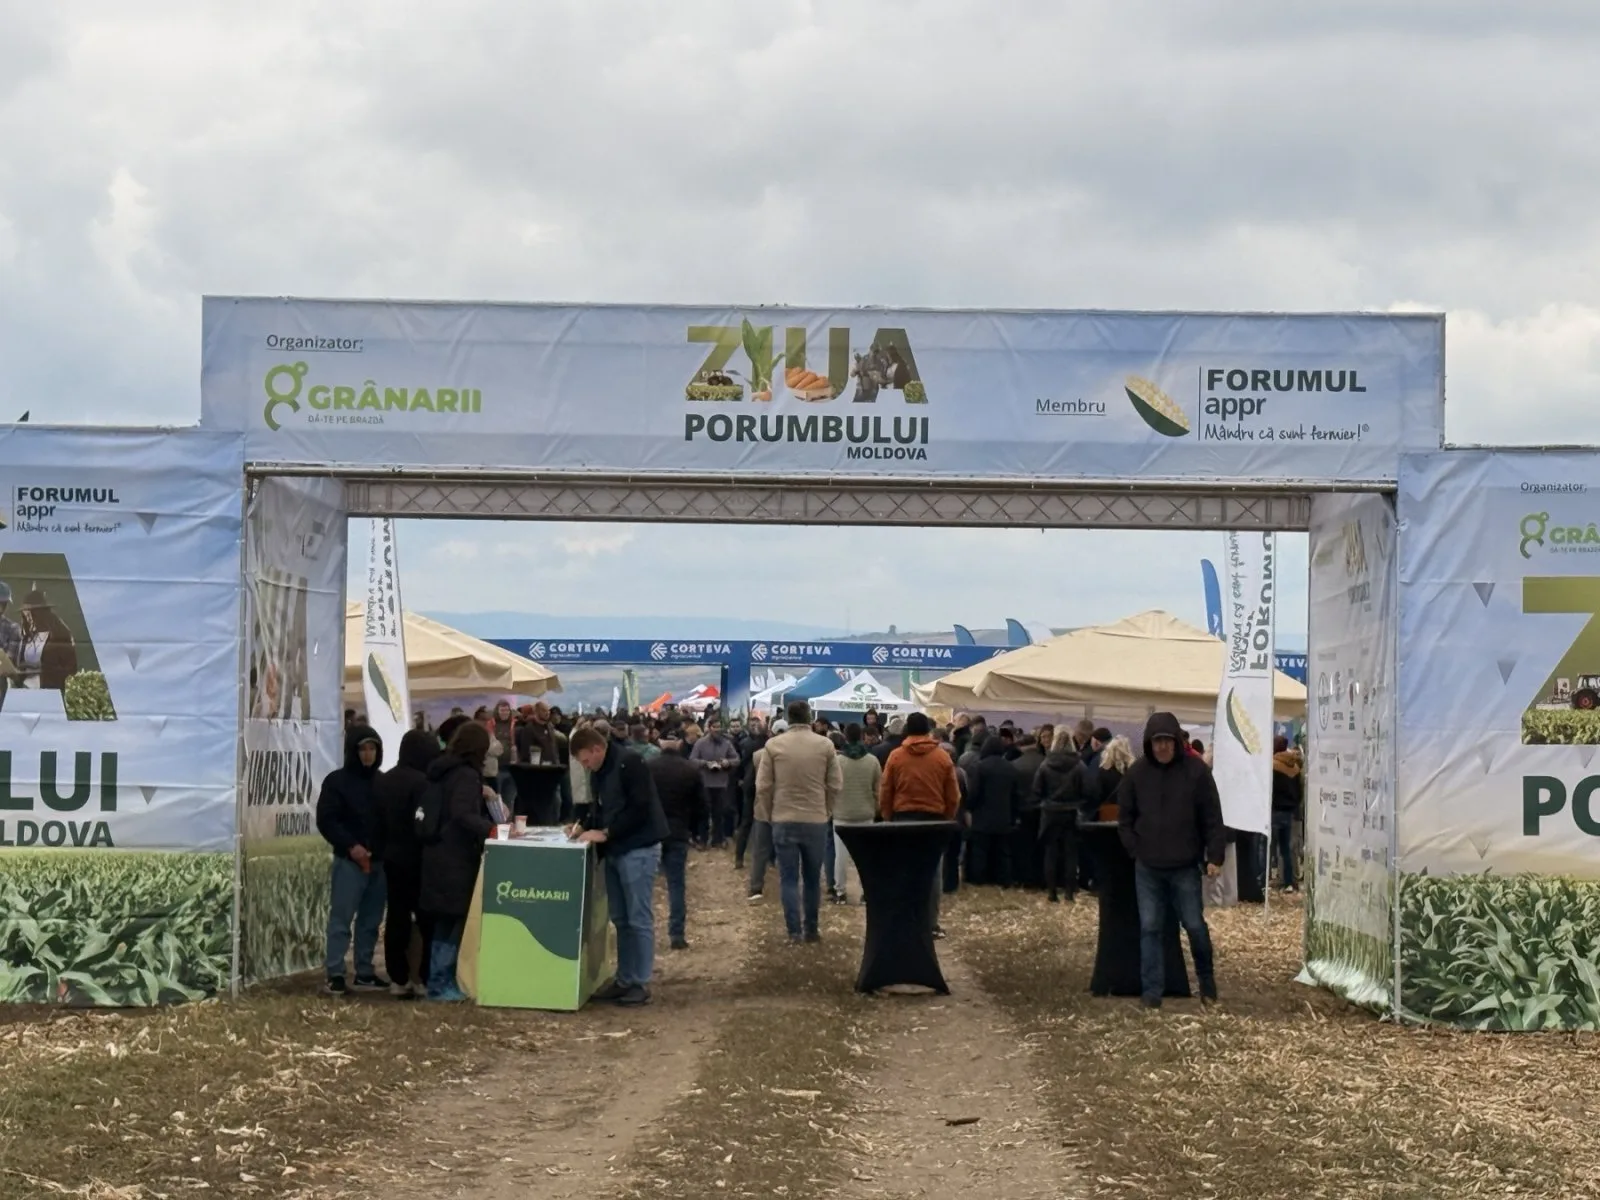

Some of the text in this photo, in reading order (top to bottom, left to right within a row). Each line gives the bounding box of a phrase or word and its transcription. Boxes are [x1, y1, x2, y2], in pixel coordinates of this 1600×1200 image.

[266, 334, 363, 351] Organizator:
[686, 324, 929, 404] ZIUA
[1207, 368, 1367, 393] FORUMUL
[307, 379, 482, 414] GRÂNARII
[1036, 398, 1106, 414] Membru
[1204, 396, 1267, 421] appr
[684, 413, 929, 445] PORUMBULUI
[1204, 423, 1254, 441] Mândru
[1258, 426, 1274, 441] că
[1278, 423, 1306, 441] sunt
[847, 446, 927, 460] MOLDOVA
[17, 487, 120, 503] FORUMUL
[16, 504, 56, 521] appr
[549, 642, 610, 653] CORTEVA
[670, 643, 732, 654] CORTEVA
[771, 645, 832, 656] CORTEVA
[892, 647, 952, 659] CORTEVA
